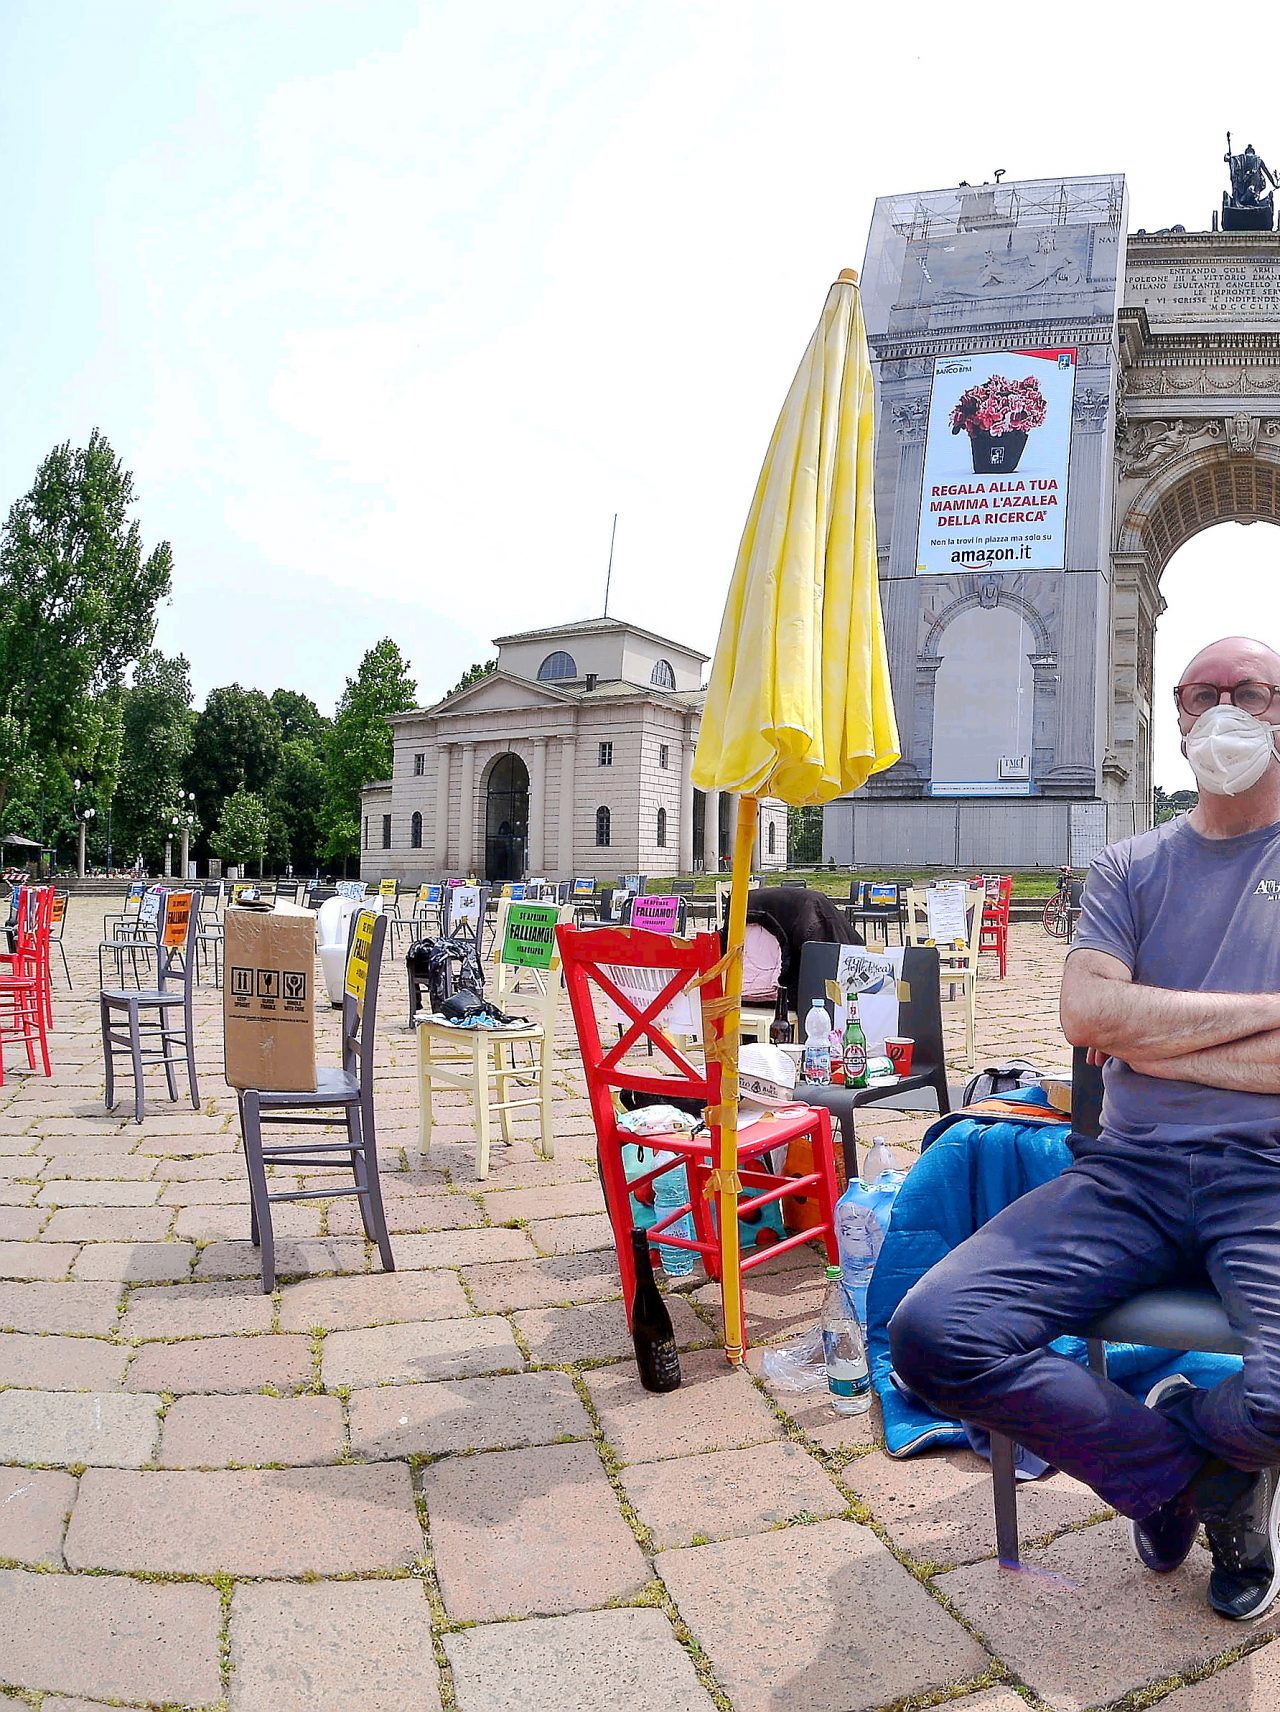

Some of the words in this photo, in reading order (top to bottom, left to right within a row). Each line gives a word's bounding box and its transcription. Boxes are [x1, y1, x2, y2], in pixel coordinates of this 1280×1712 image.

[936, 367, 958, 375] BANCO
[931, 482, 985, 497] REGALA
[989, 480, 1025, 494] ALLA
[1029, 479, 1059, 491] TUA
[930, 498, 989, 512] MAMMA
[993, 495, 1058, 509] L'AZALEA
[937, 513, 981, 527] DELLA
[930, 538, 946, 546] Non
[947, 537, 955, 546] la
[956, 537, 974, 546] trovi
[975, 536, 984, 545] in
[985, 536, 1009, 547] piazza
[1024, 534, 1042, 542] solo
[951, 545, 1032, 563] amazon.it
[635, 906, 674, 918] FALLIAMO!
[510, 923, 553, 944] FALLIAMO!
